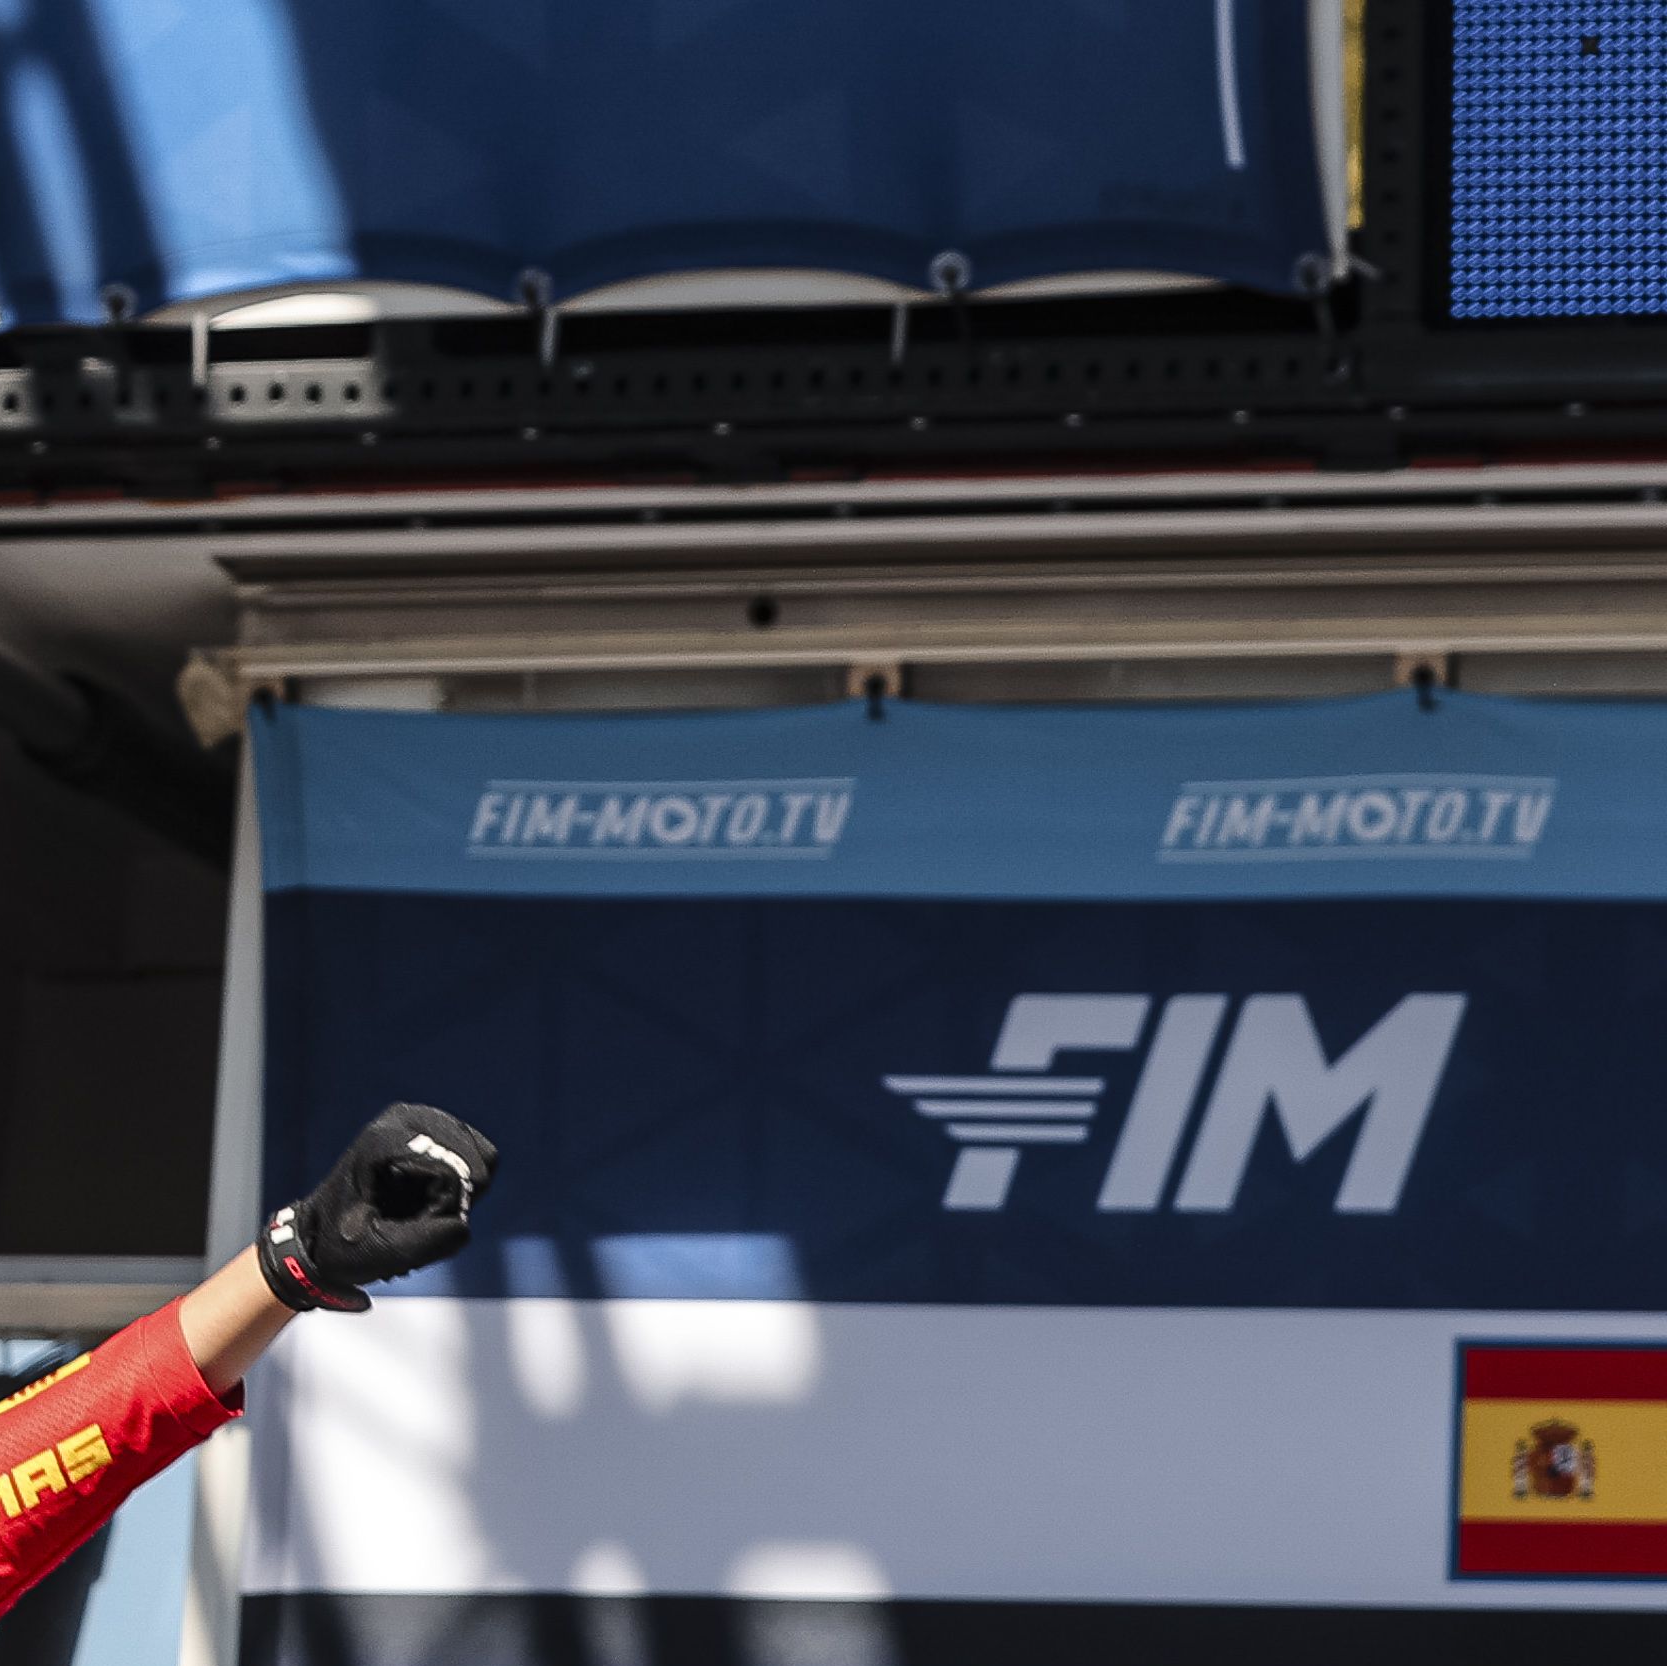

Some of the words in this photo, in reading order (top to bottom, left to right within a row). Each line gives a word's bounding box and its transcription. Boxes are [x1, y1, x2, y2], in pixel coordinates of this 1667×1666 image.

[470, 793, 851, 847] FIM-MOTO.TV
[1161, 792, 1552, 848] FIM-MOTO.TV
[885, 993, 1466, 1213] FIM
